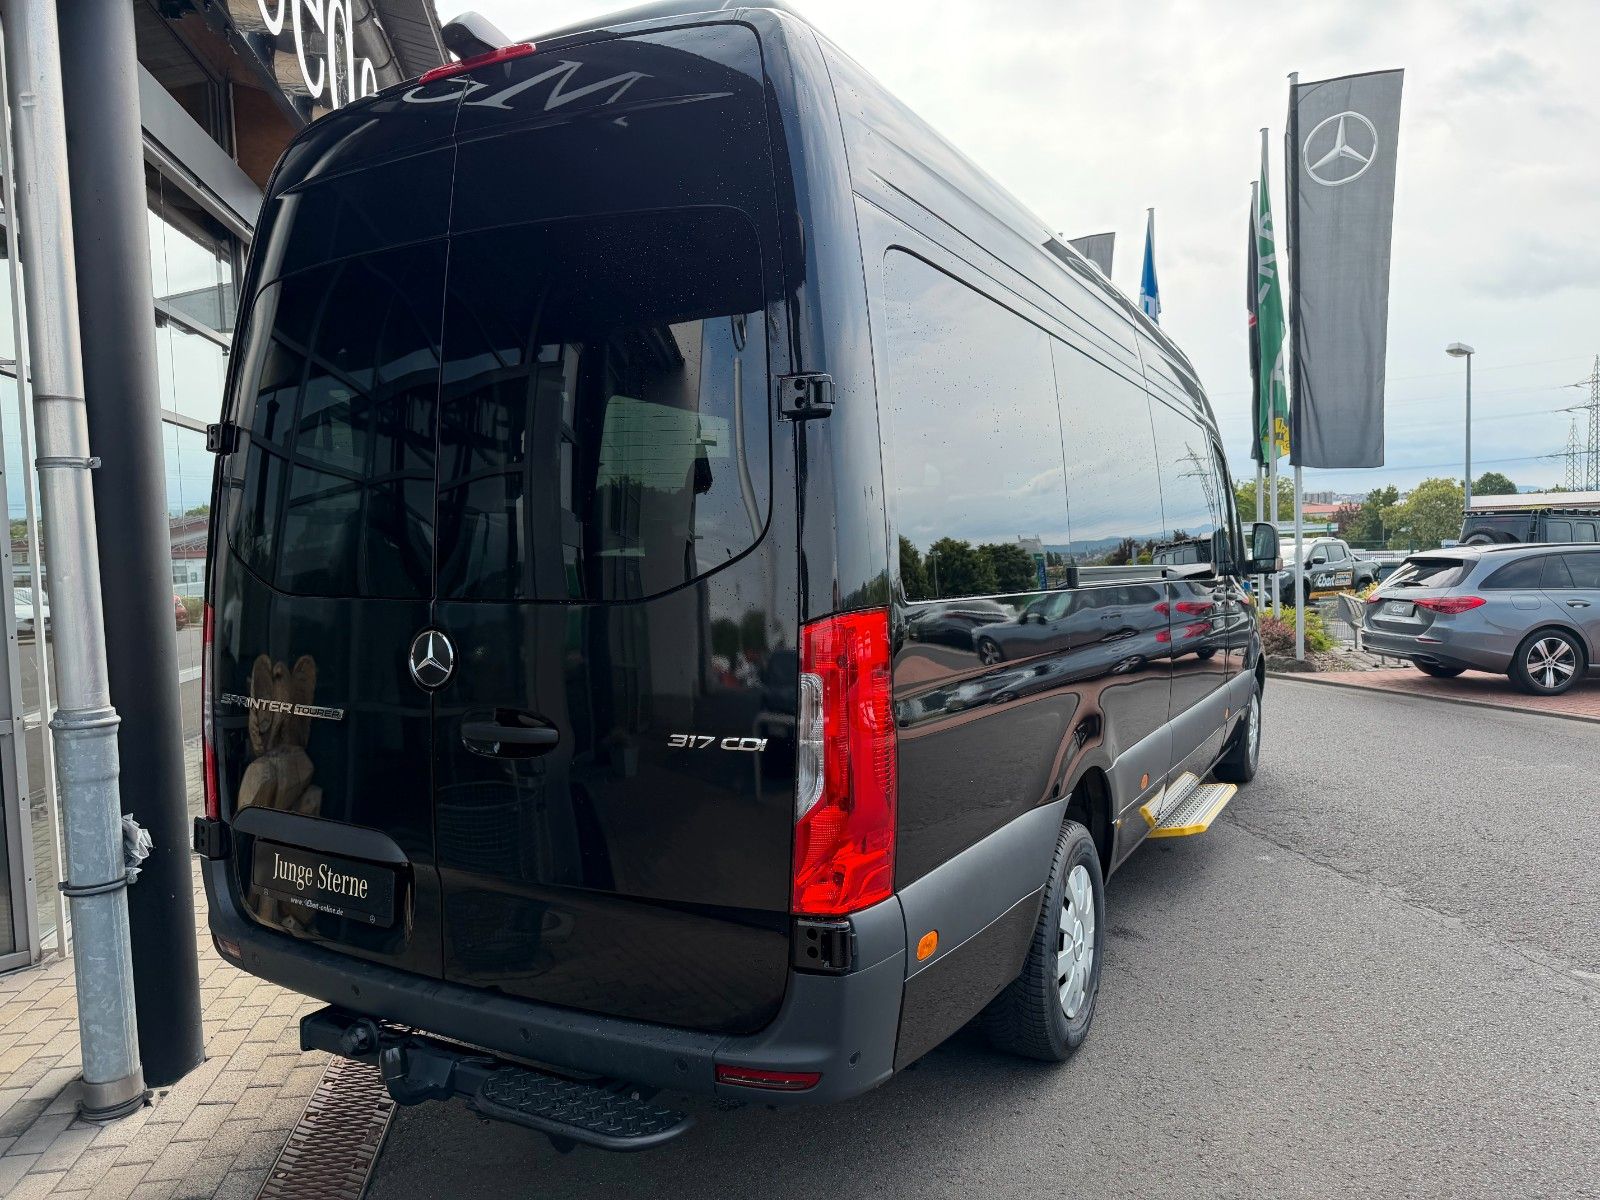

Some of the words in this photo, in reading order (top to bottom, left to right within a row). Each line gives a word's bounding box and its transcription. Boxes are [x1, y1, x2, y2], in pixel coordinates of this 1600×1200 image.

[221, 693, 293, 713] SPRINTER
[295, 705, 342, 719] TOURER
[667, 733, 716, 749] 317
[720, 737, 768, 751] CDI
[273, 853, 313, 890] Junge
[317, 863, 368, 899] Sterne
